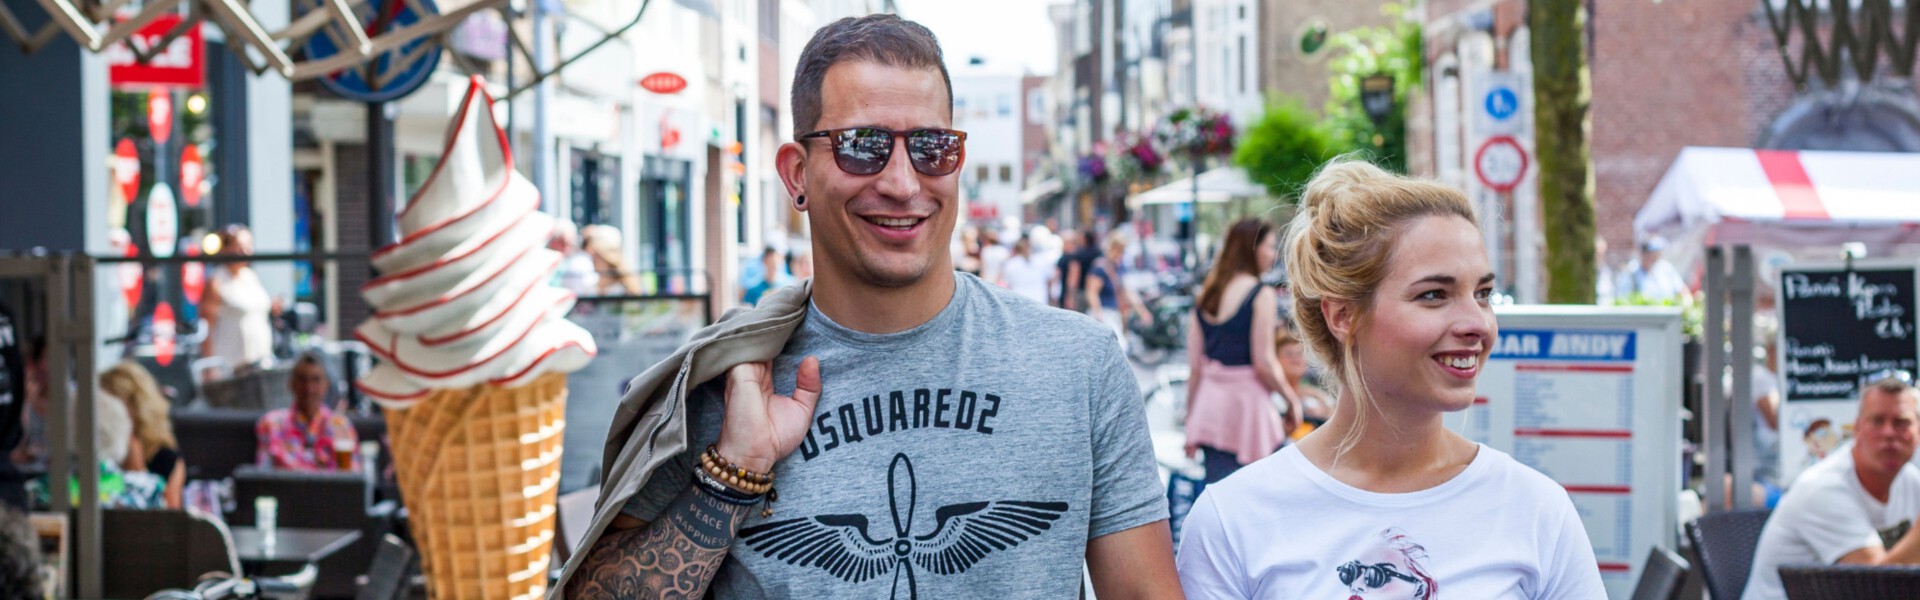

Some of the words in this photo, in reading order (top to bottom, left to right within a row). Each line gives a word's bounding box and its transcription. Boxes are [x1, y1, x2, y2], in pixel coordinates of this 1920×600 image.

[1549, 333, 1629, 357] ANDY
[675, 512, 728, 546] HAPPINESS
[689, 503, 723, 530] PEACE
